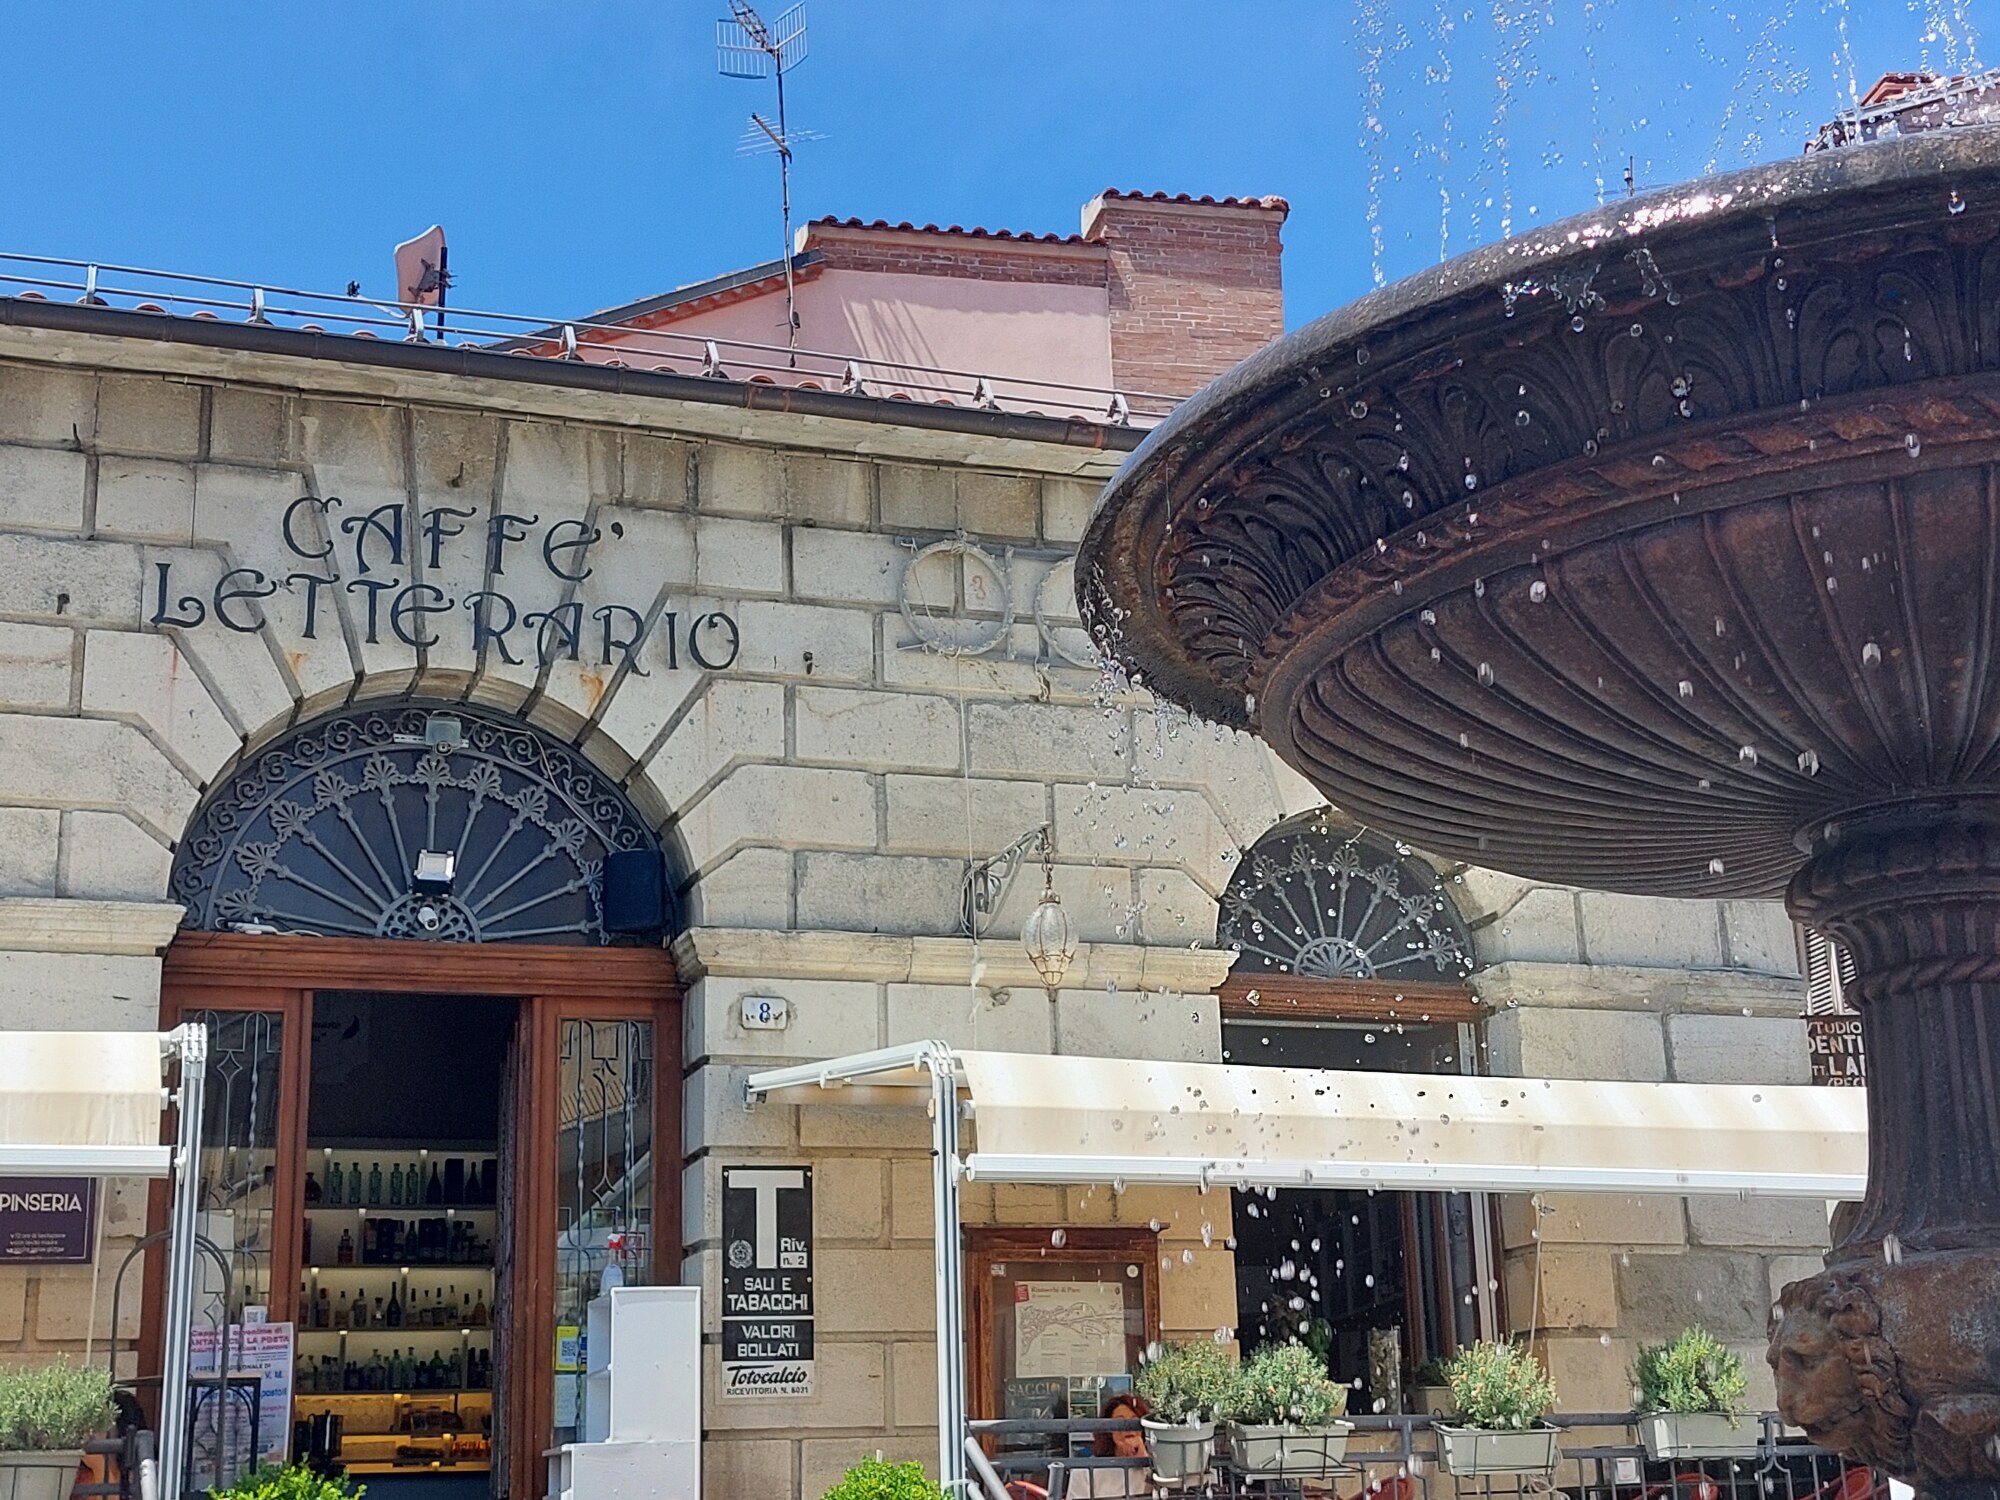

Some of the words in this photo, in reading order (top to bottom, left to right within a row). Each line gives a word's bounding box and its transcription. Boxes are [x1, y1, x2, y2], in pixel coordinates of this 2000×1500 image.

[151, 562, 739, 677] LETTERARIO
[759, 1002, 771, 1023] 8
[0, 1193, 82, 1212] PINSERIA
[728, 1170, 804, 1269] T
[780, 1238, 807, 1251] Riv.
[798, 1256, 804, 1265] 2
[744, 1278, 774, 1291] SALI
[782, 1277, 791, 1291] E
[727, 1293, 808, 1311] TABACCHI
[741, 1325, 795, 1339] VALORI
[737, 1343, 799, 1357] BOLLATI
[727, 1364, 807, 1387] Totocalcio
[727, 1387, 778, 1395] RICEVITORIA
